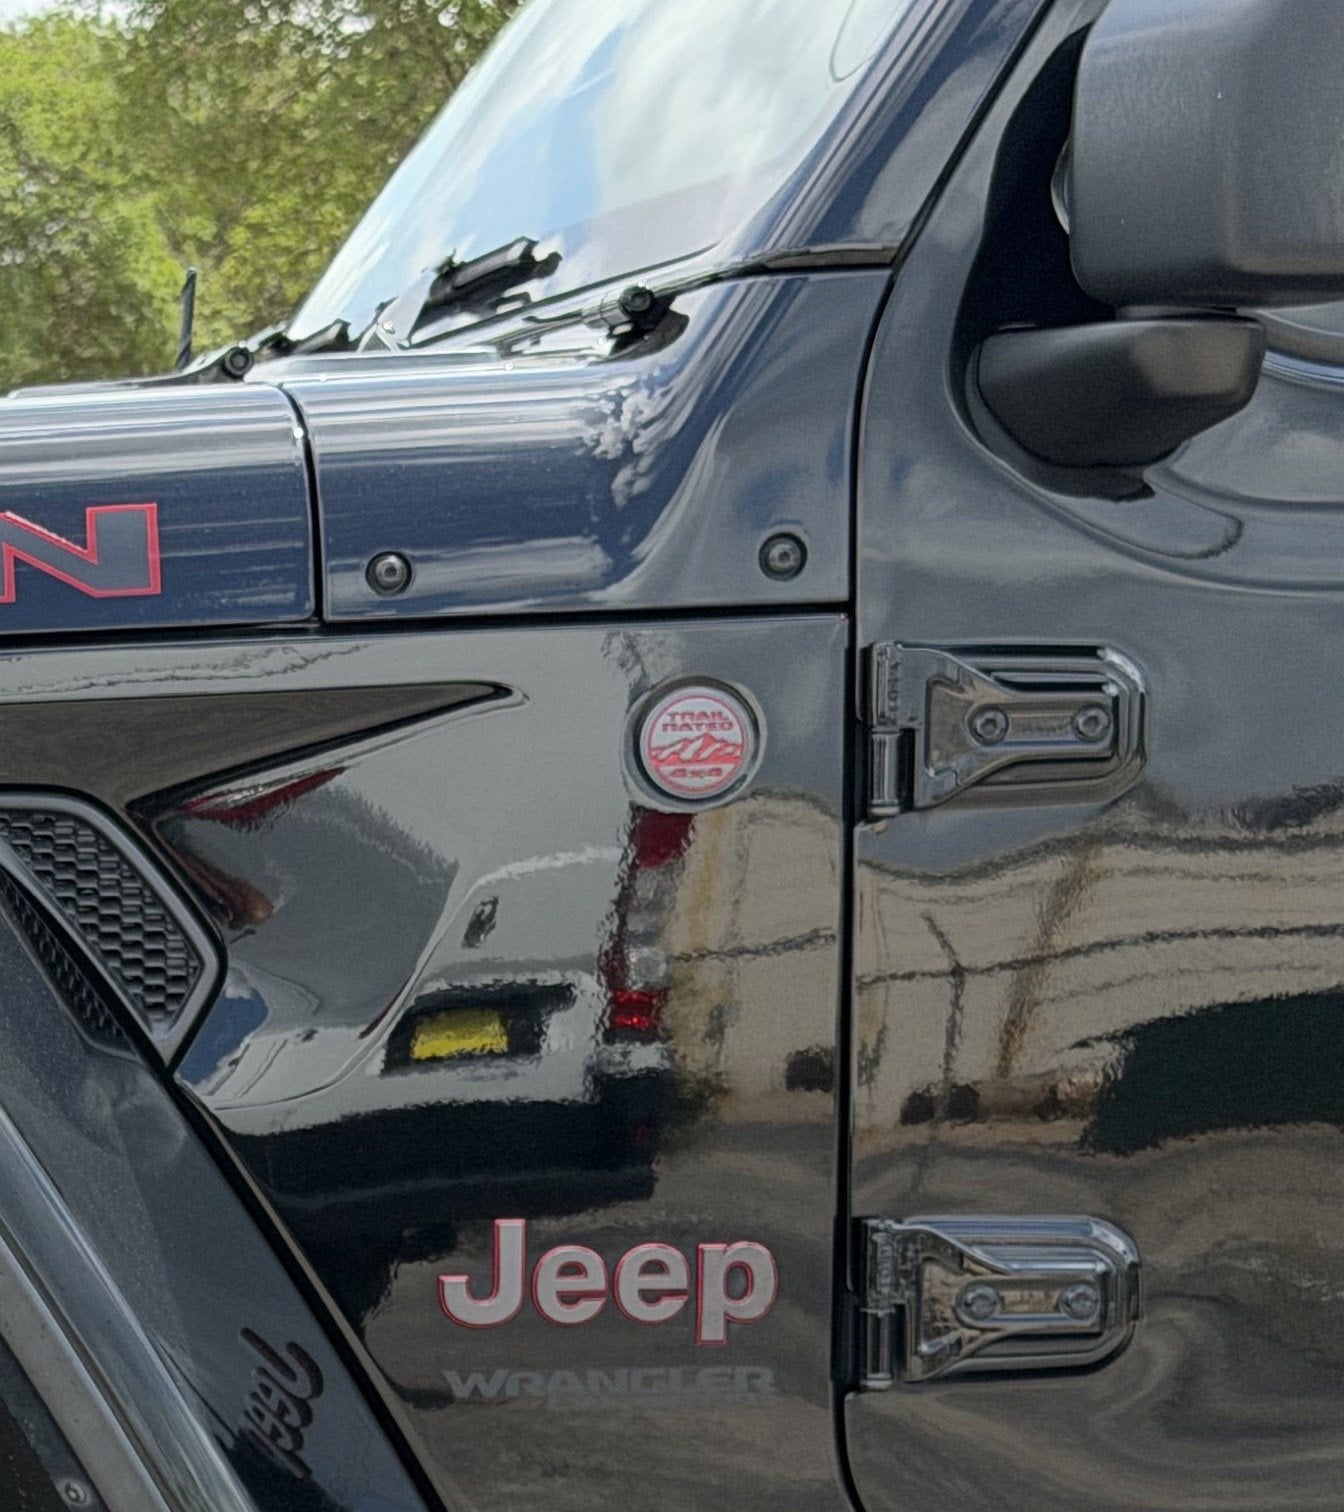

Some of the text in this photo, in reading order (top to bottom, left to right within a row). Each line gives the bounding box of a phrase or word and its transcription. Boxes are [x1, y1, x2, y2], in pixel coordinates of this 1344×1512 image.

[662, 721, 734, 732] RATED
[666, 710, 730, 722] TRAIL
[438, 1217, 779, 1346] Jeep
[442, 1365, 780, 1400] WRANGLER
